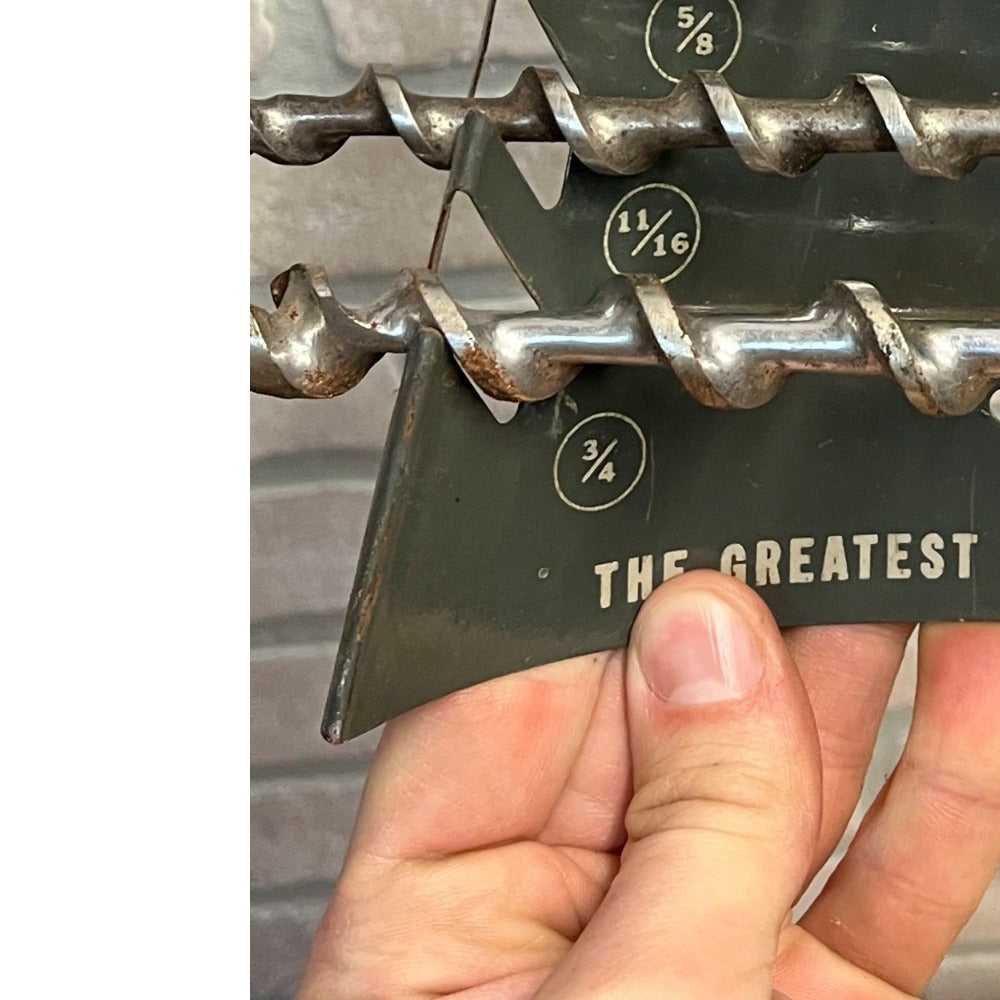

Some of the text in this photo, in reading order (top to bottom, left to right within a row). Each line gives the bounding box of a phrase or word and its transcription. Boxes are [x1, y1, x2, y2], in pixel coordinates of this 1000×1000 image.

[676, 5, 714, 55] 5/8
[617, 208, 690, 257] 11/16
[581, 439, 618, 484] 3/4
[720, 532, 979, 587] GREATEST
